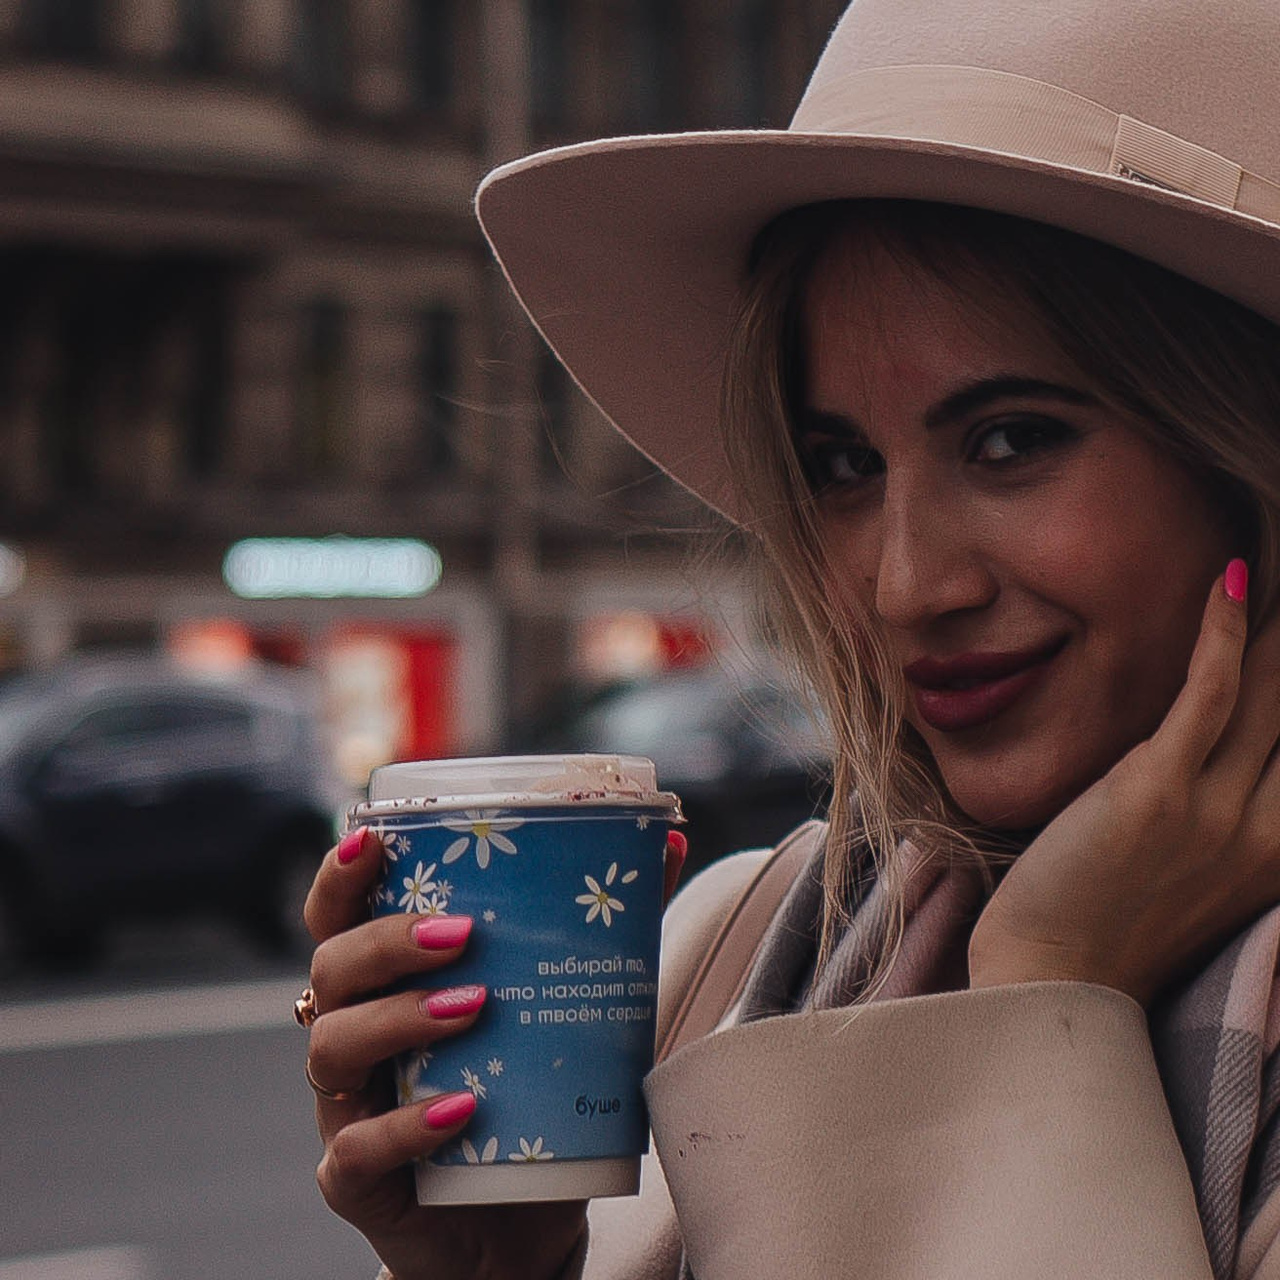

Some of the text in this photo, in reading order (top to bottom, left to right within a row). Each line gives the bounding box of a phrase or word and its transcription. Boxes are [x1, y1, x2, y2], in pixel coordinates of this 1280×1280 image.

[538, 955, 647, 977] выбирай то,
[494, 986, 535, 1001] что
[541, 982, 623, 1000] находит
[520, 1010, 531, 1024] в
[538, 1004, 602, 1024] твоём
[575, 1095, 620, 1120] буше
